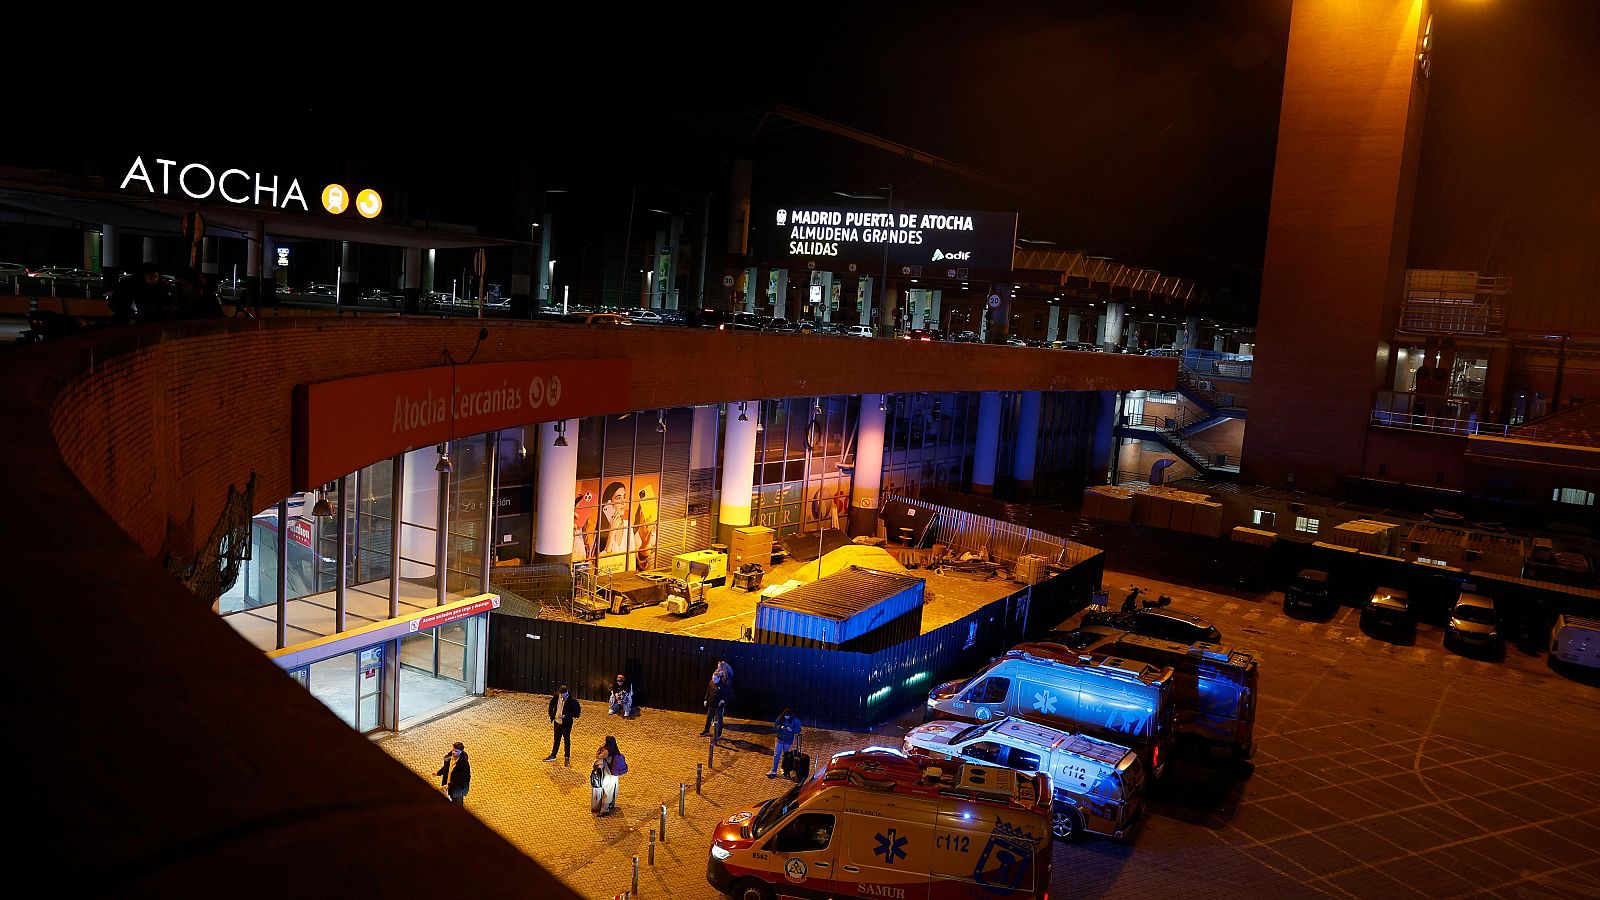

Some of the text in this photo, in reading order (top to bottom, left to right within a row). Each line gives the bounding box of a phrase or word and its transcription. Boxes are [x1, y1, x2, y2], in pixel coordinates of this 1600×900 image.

[120, 155, 309, 211] ATOCHA
[791, 210, 974, 231] MADRID PUERTA DE ATOCHA
[790, 225, 923, 245] ALMUDENA GRANDES
[789, 241, 838, 256] SALIDAS
[944, 250, 971, 261] adif
[392, 378, 522, 434] Atocha Cercanías
[857, 883, 906, 899] SAMUR
